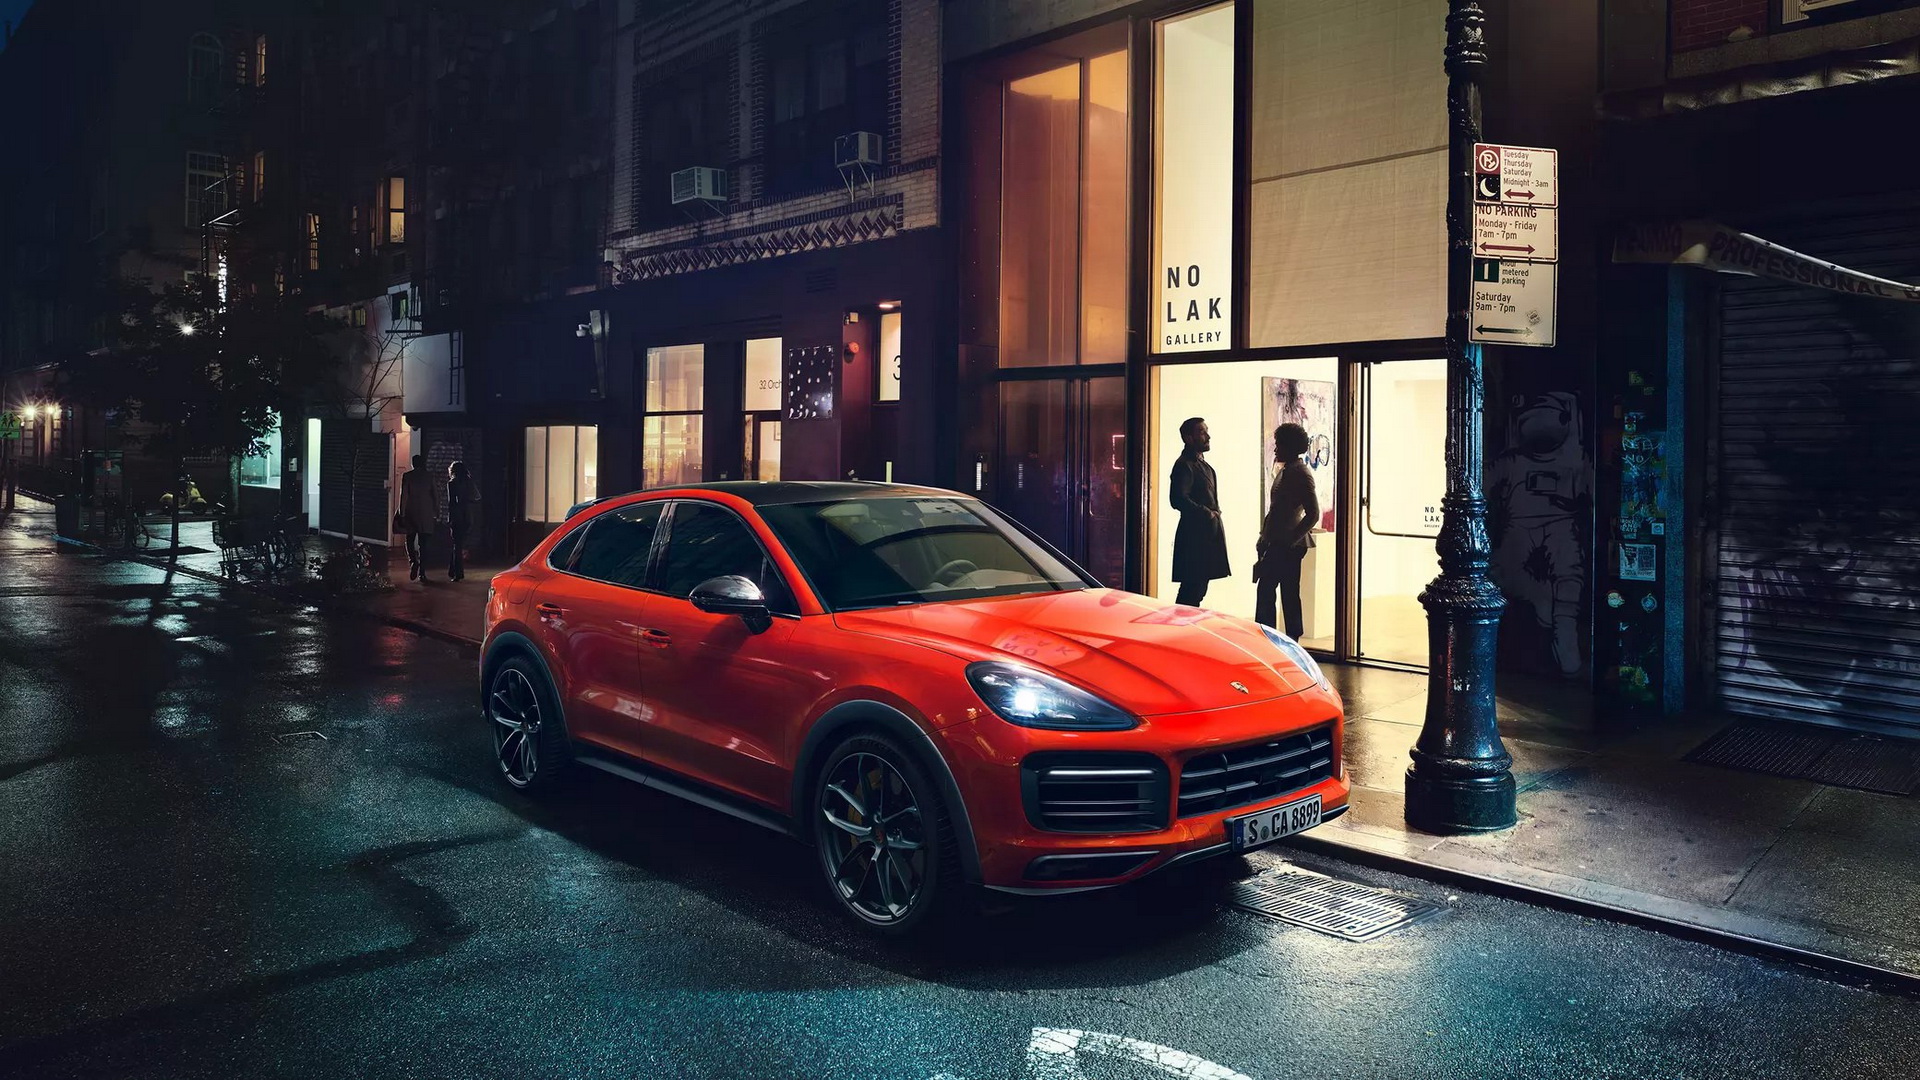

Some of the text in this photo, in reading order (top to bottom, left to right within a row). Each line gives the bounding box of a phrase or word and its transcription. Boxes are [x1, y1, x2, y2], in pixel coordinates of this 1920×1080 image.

[1504, 150, 1529, 160] Tuesday
[1504, 159, 1532, 169] Thursday
[1504, 168, 1532, 177] Saturday
[1504, 178, 1530, 187] Midnight
[1479, 205, 1537, 218] NO PARKING
[1479, 219, 1507, 230] Monday
[1515, 221, 1537, 232] Friday
[1479, 229, 1494, 238] 7am
[1501, 231, 1517, 240] 7pm
[1710, 231, 1892, 297] PROFESSIONAL
[1167, 265, 1200, 288] NO
[1502, 269, 1529, 277] metered
[1502, 277, 1526, 288] parking
[1476, 292, 1511, 303] Saturday
[1167, 297, 1221, 322] LAK
[1475, 302, 1492, 311] 9am
[1499, 303, 1516, 313] 7pm
[1166, 331, 1221, 345] GALLERY
[1248, 800, 1320, 844] S CA 8899
